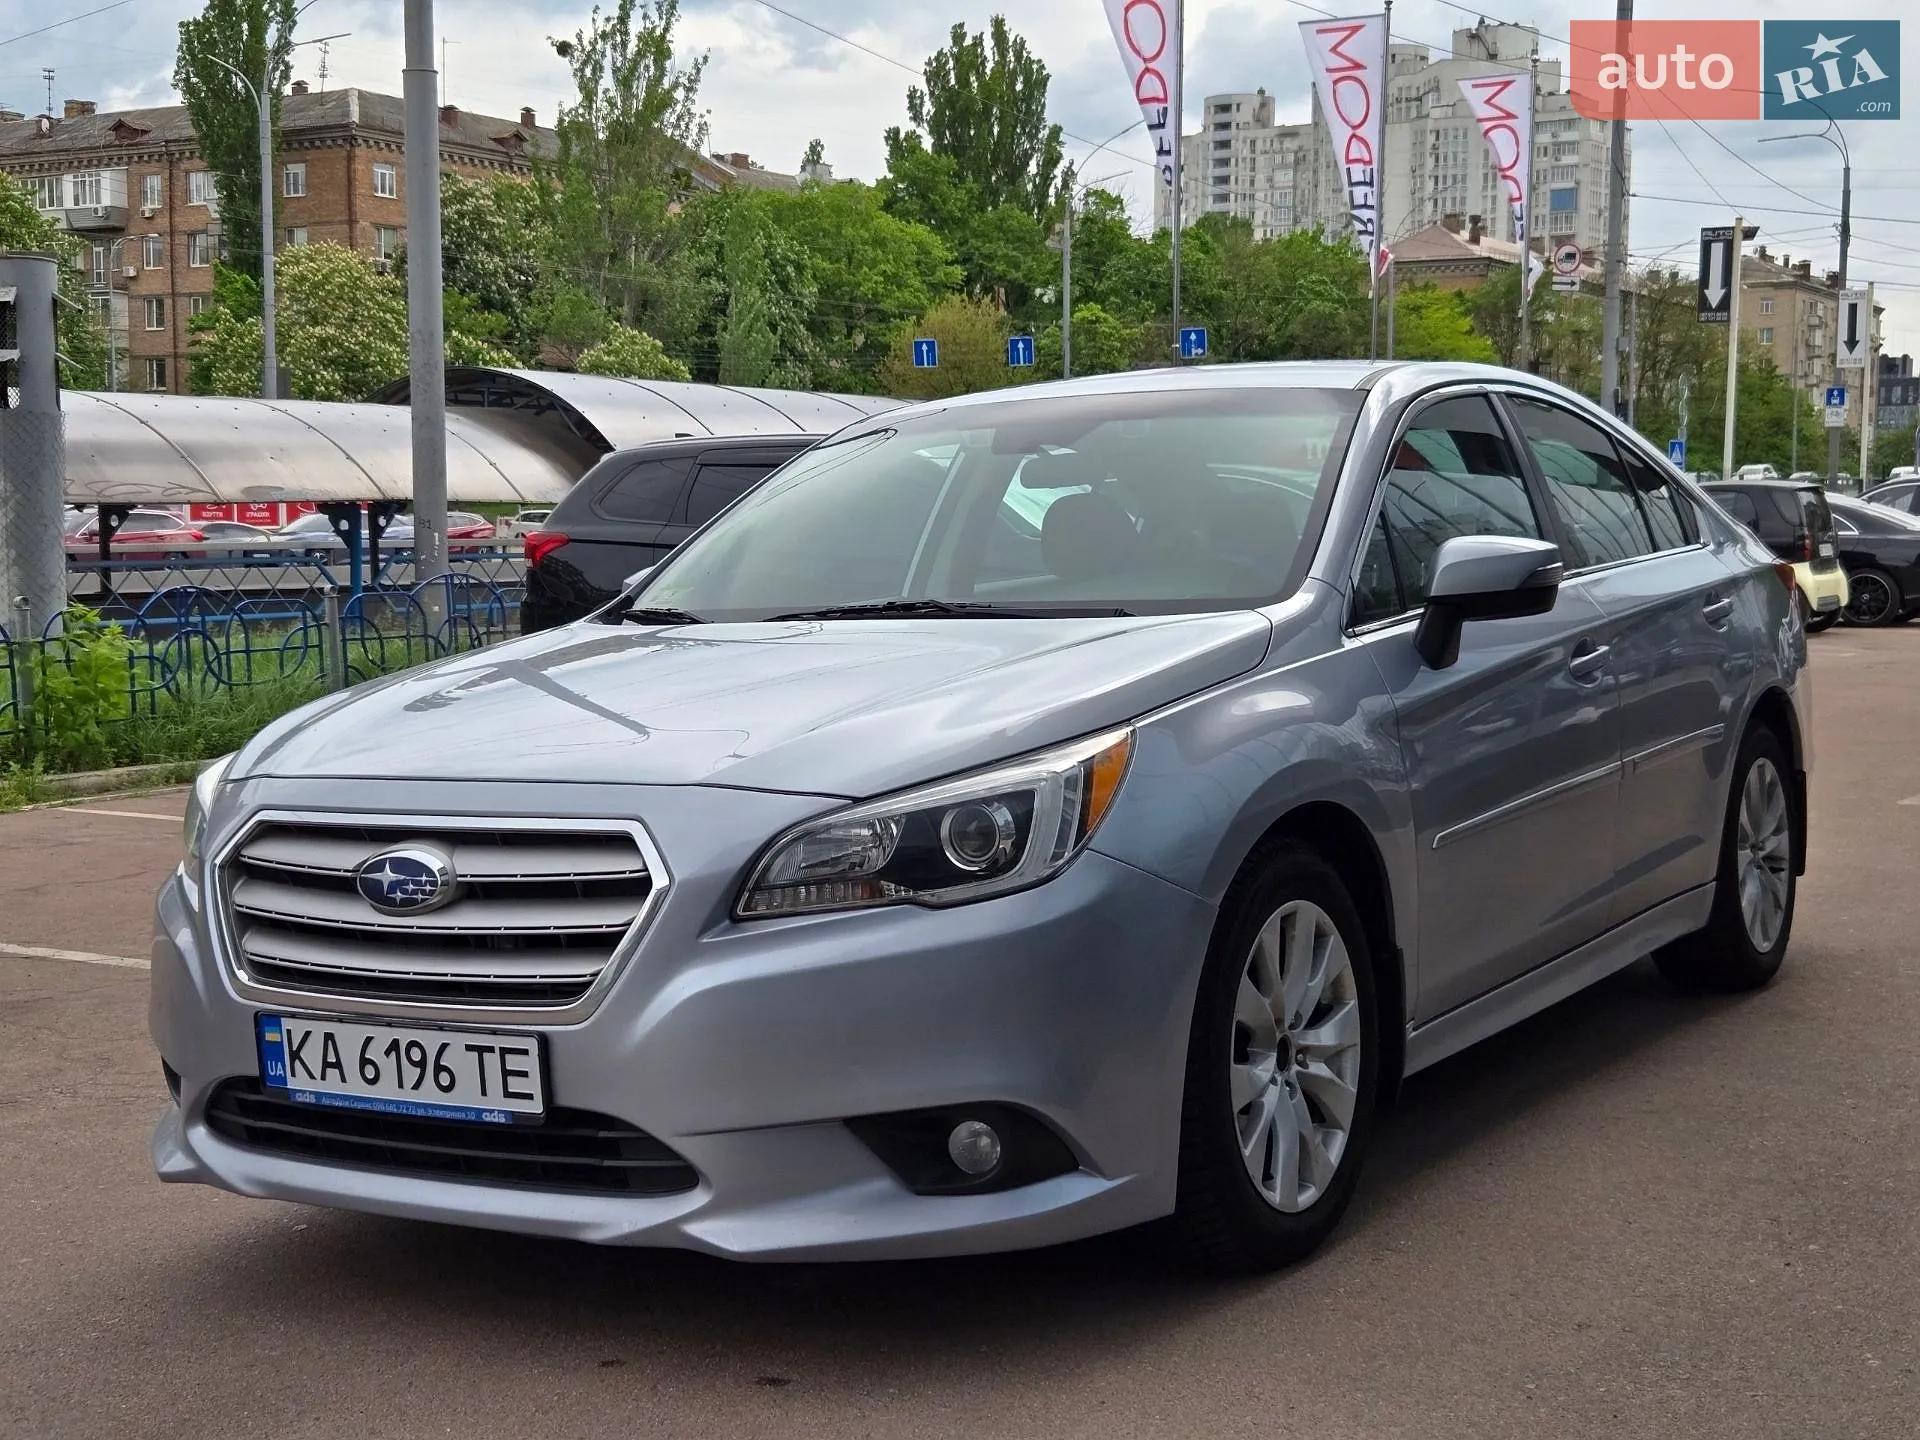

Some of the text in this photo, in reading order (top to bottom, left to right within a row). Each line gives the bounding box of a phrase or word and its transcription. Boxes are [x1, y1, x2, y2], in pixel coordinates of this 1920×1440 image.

[267, 1060, 285, 1077] UA
[286, 1028, 535, 1101] KA 6196 TE
[295, 1091, 316, 1103] ads
[481, 1110, 506, 1122] ads
